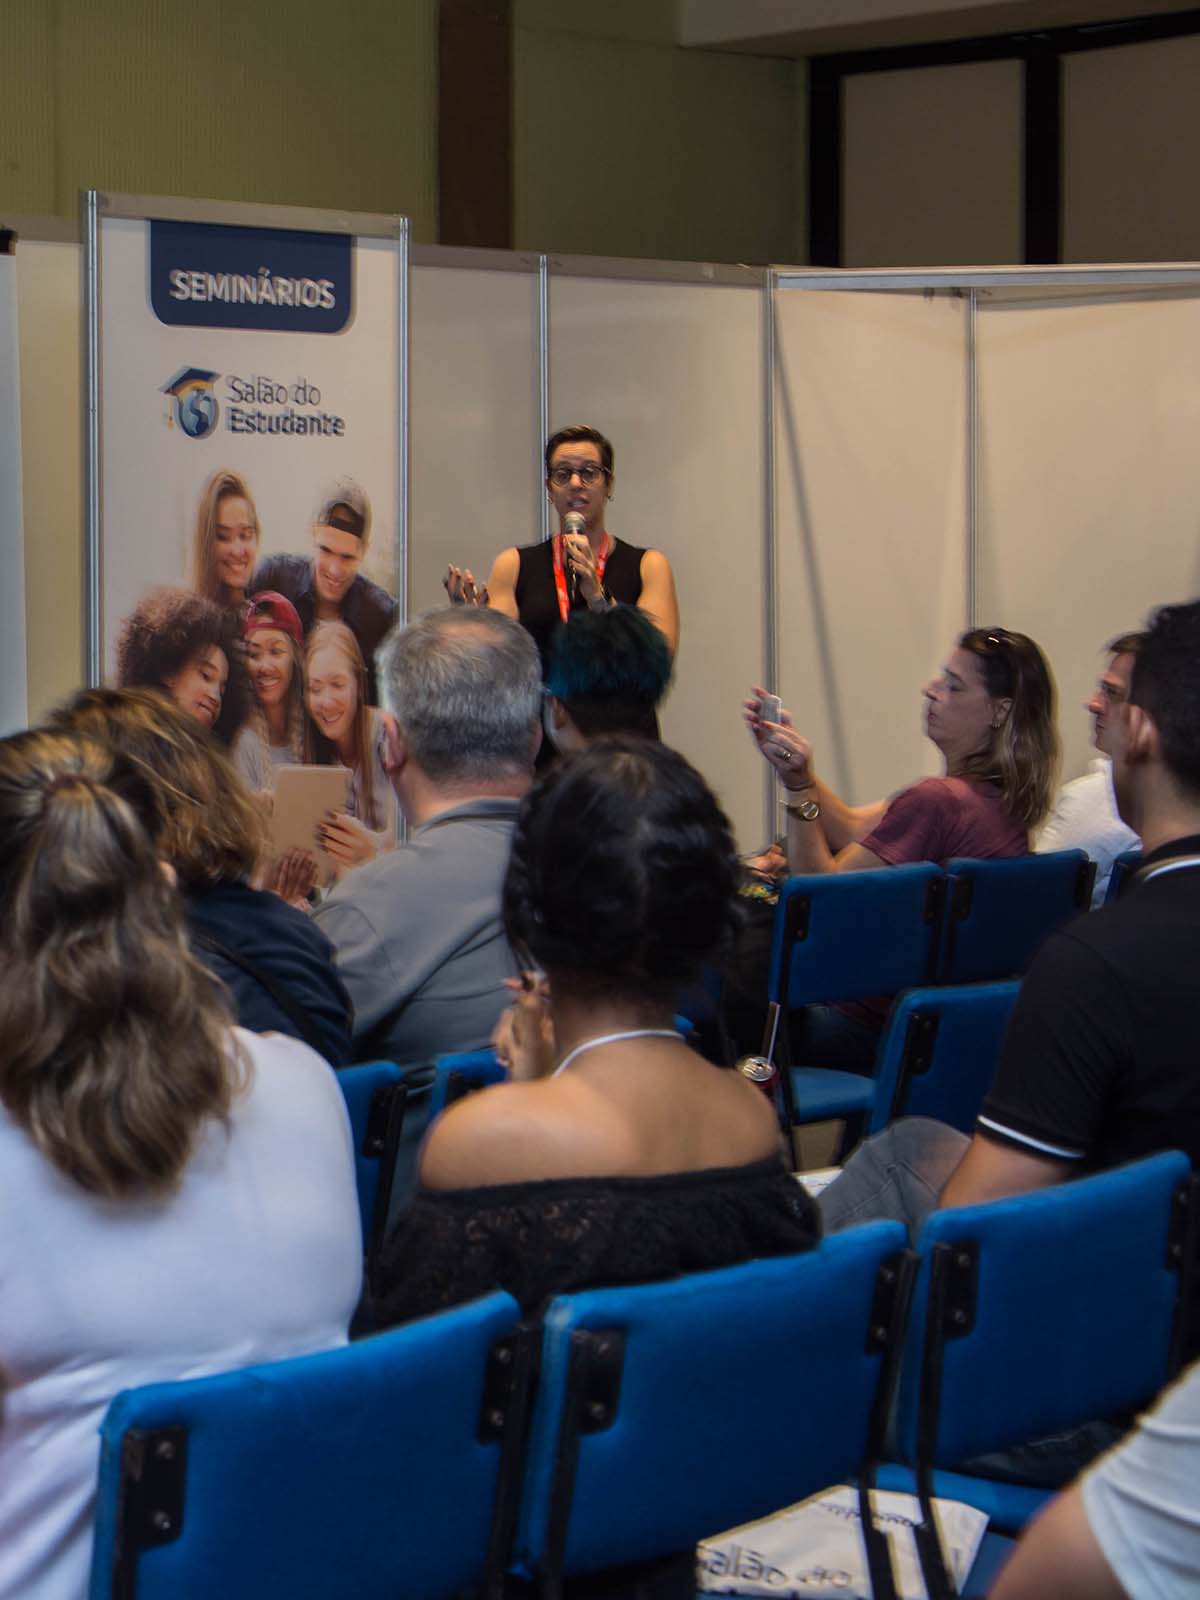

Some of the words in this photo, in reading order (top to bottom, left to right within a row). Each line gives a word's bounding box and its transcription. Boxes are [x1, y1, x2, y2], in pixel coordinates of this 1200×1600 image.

[170, 266, 336, 310] SEMINÁRIOS
[225, 373, 288, 405] Salão
[291, 376, 322, 406] do
[226, 406, 347, 438] Estudante
